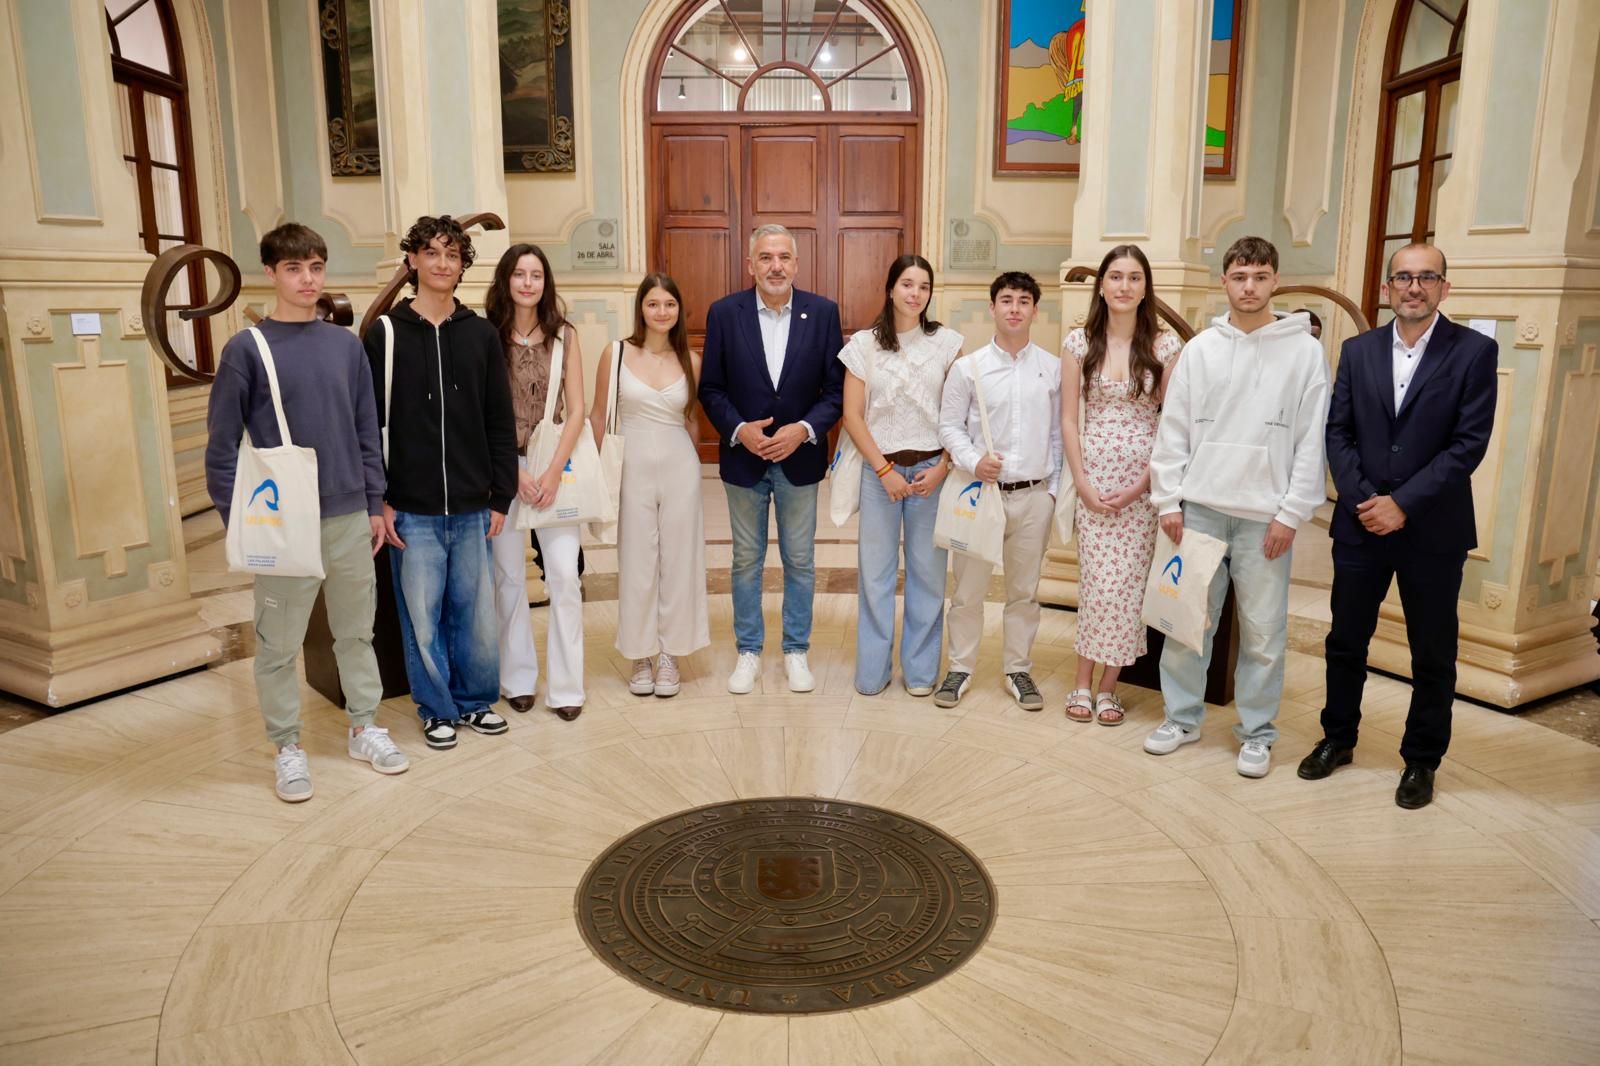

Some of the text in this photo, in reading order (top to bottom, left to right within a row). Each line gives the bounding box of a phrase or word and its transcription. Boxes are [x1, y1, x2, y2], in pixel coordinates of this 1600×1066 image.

[577, 251, 586, 259] 26
[586, 251, 596, 259] DE
[590, 802, 985, 1007] UNIVERSIDAD DE LAS PALMAS DE GRAN CANARIA
